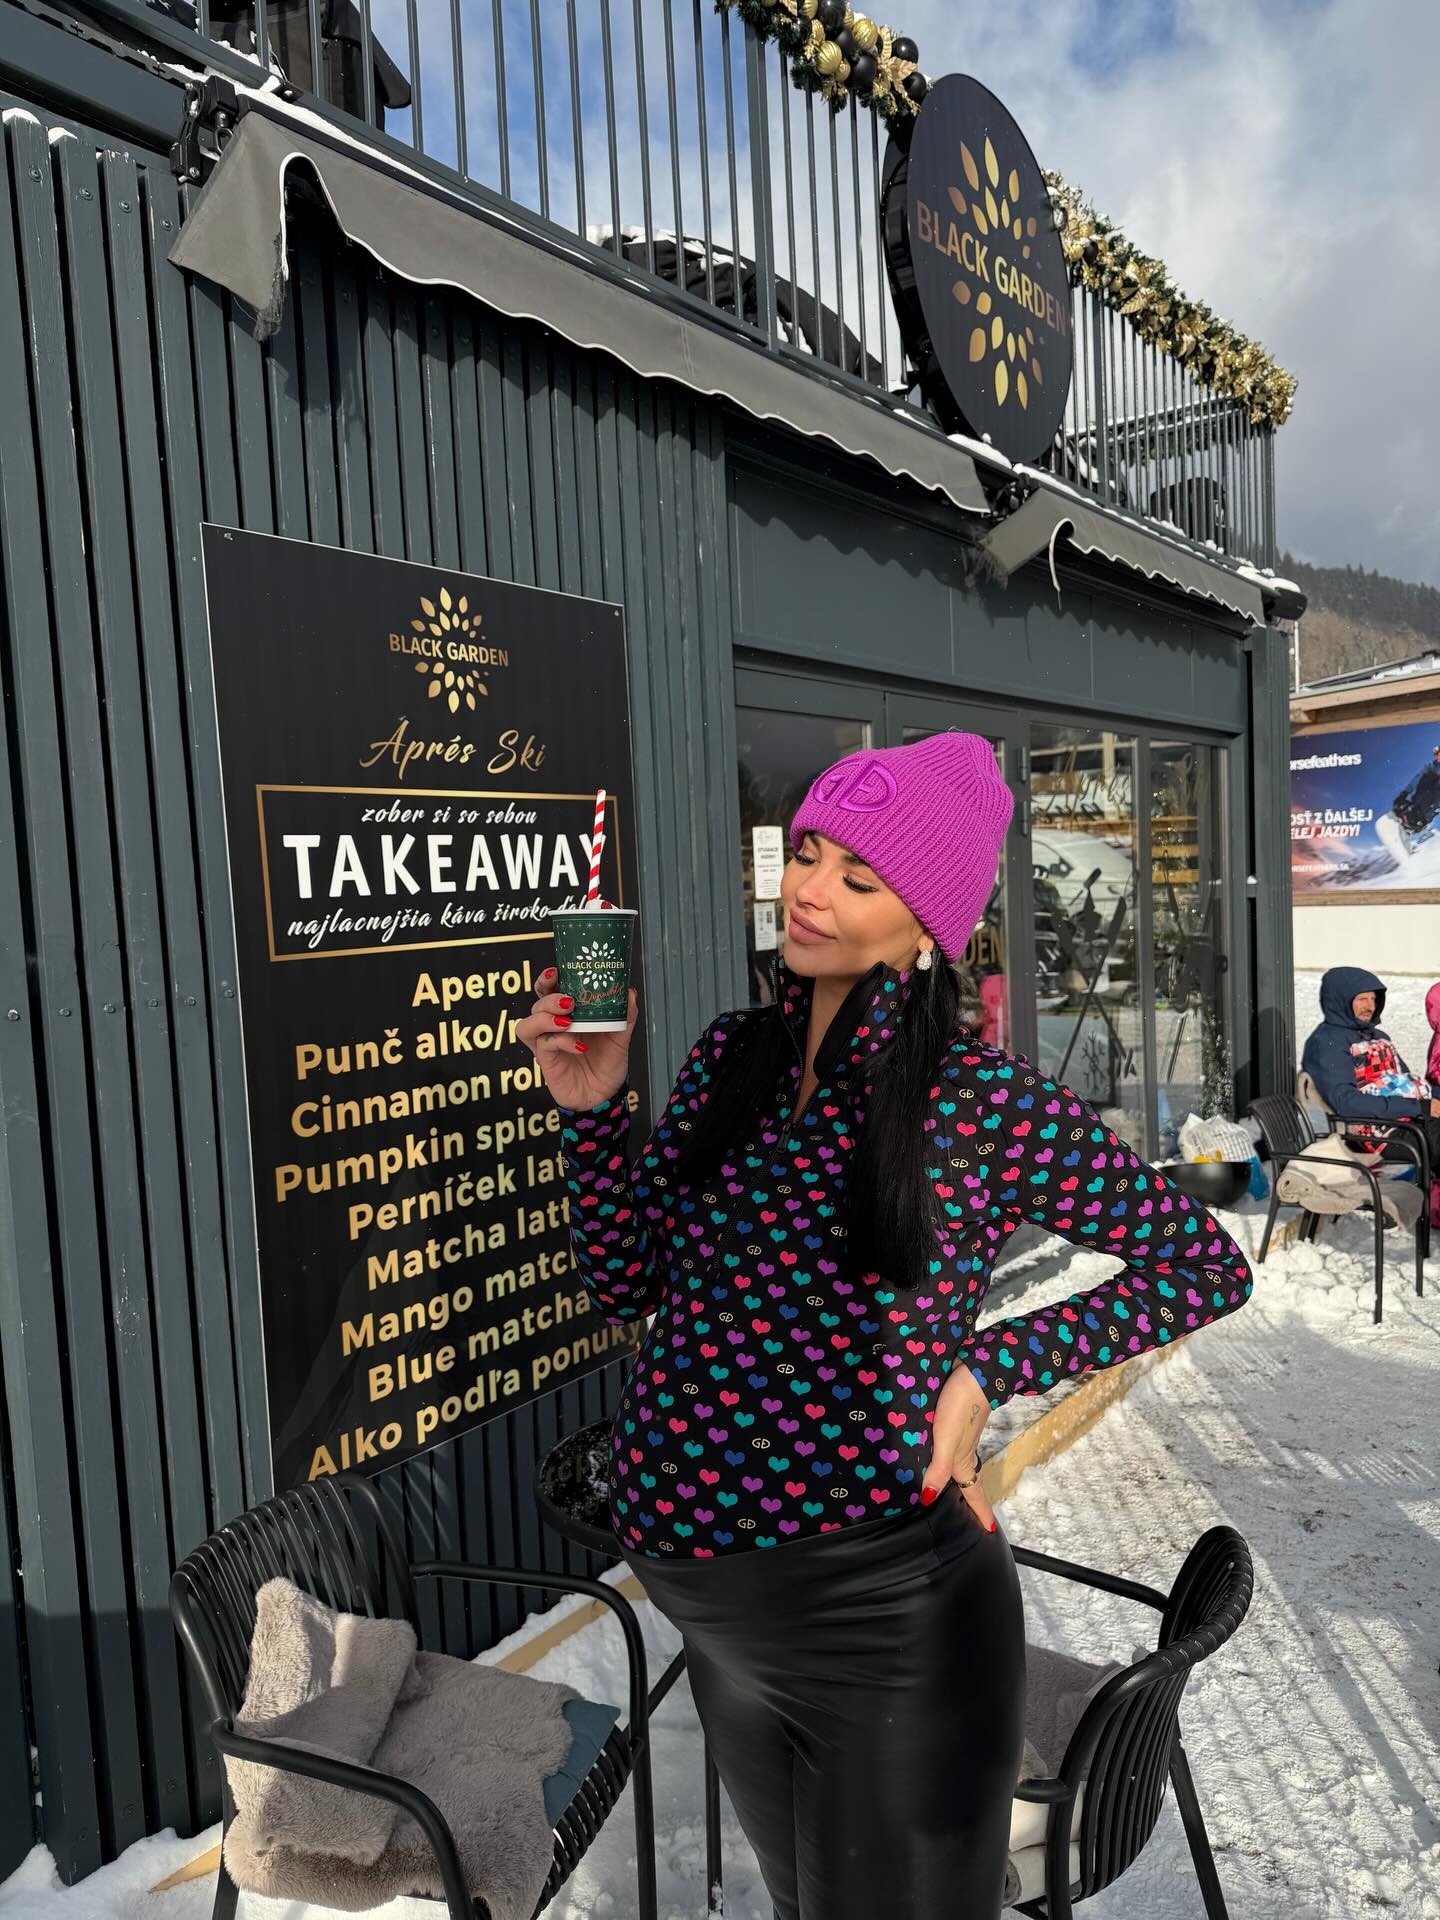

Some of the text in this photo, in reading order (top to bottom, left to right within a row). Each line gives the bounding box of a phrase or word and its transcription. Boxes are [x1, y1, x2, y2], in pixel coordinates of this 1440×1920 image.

[917, 199, 1068, 337] BLACK GARDEN
[389, 633, 509, 667] BLACK GARDEN
[487, 729, 547, 774] Ski
[361, 799, 537, 825] zober si so sebou
[1315, 812, 1323, 824] Z
[283, 833, 606, 899] TAKEAWAY
[287, 908, 432, 949] najlacnejšia
[440, 902, 487, 928] káva
[493, 897, 551, 922] široko
[412, 960, 532, 1011] Aperol
[567, 961, 625, 969] BLACK GARDEN
[295, 1029, 403, 1081] Punč
[291, 1057, 548, 1138] Cinnamon rol
[274, 1106, 560, 1203] Pumpkin spice
[348, 1150, 566, 1240] Perníček lat
[367, 1196, 570, 1291] Matcha latt
[341, 1285, 474, 1357] Mango
[368, 1289, 591, 1403] Blue matcha
[307, 1318, 641, 1482] Alko podľa ponuky
